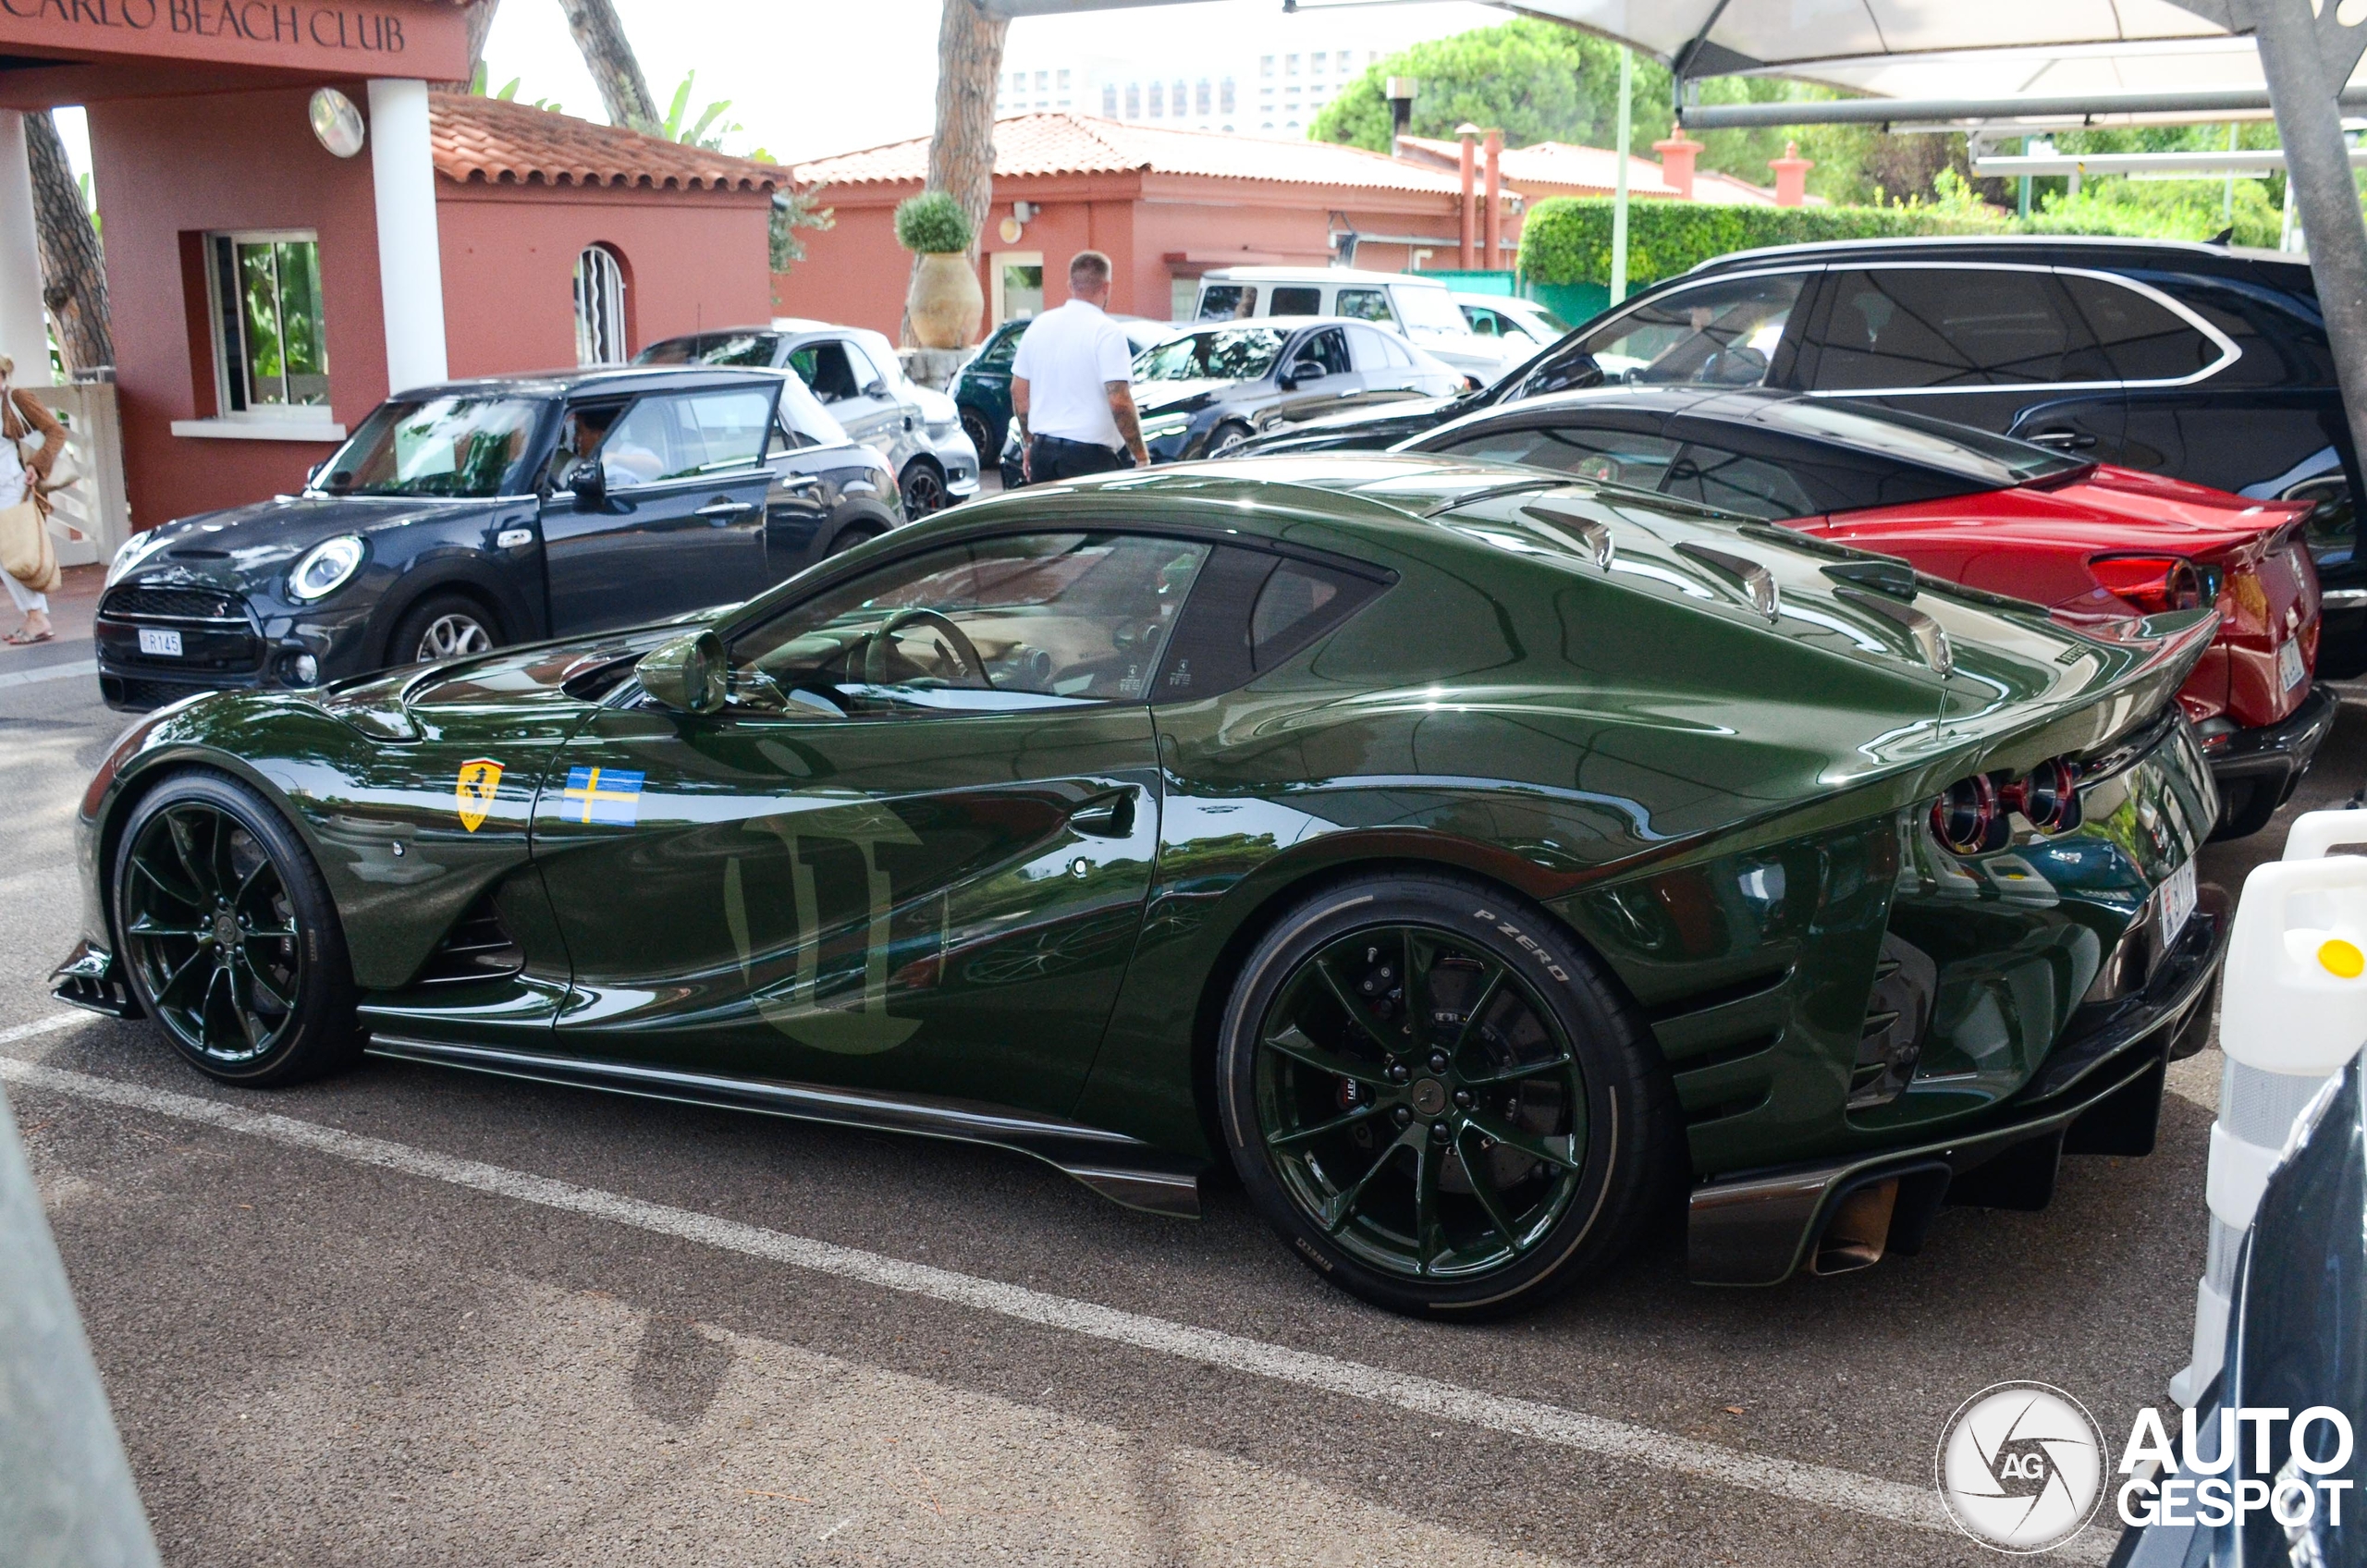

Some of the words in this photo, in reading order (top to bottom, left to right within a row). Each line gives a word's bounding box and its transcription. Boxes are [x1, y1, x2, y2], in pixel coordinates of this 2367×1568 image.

[170, 0, 298, 43] BEACH
[310, 10, 404, 52] CLUB
[149, 634, 178, 652] R145
[1473, 909, 1496, 920] P
[1497, 922, 1570, 982] ZERO
